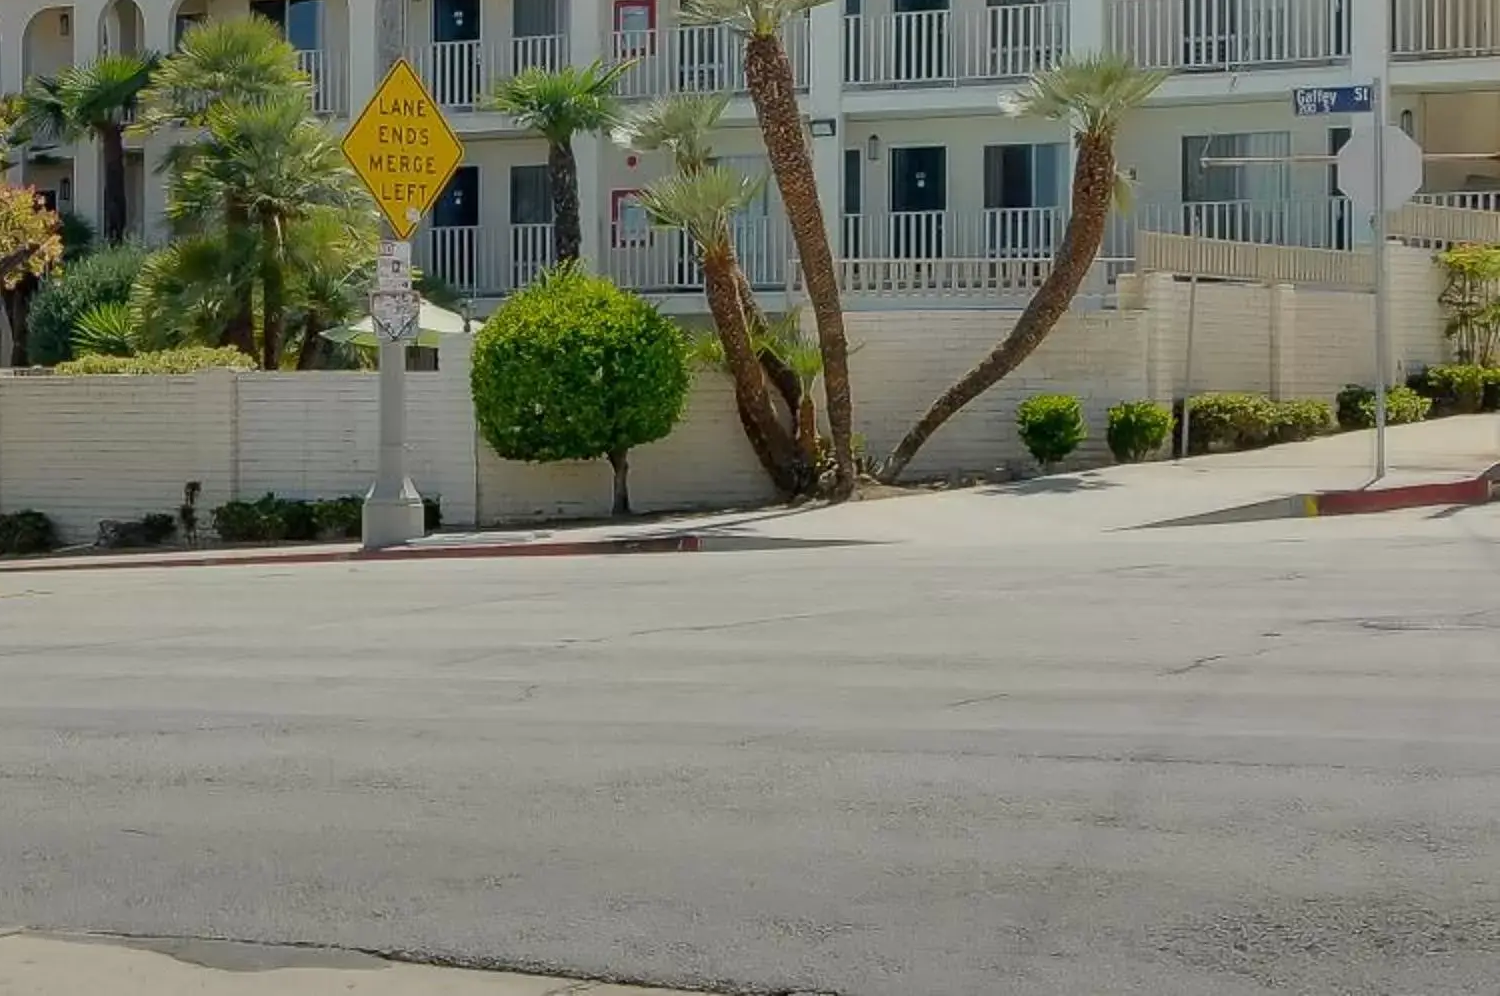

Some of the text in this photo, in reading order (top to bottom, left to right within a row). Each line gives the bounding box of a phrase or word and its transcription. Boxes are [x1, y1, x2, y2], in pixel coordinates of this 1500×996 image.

[1353, 87, 1368, 101] St
[379, 97, 427, 117] LANE
[379, 125, 430, 146] ENDS
[369, 156, 436, 176] MERGE
[381, 183, 429, 202] LEFT
